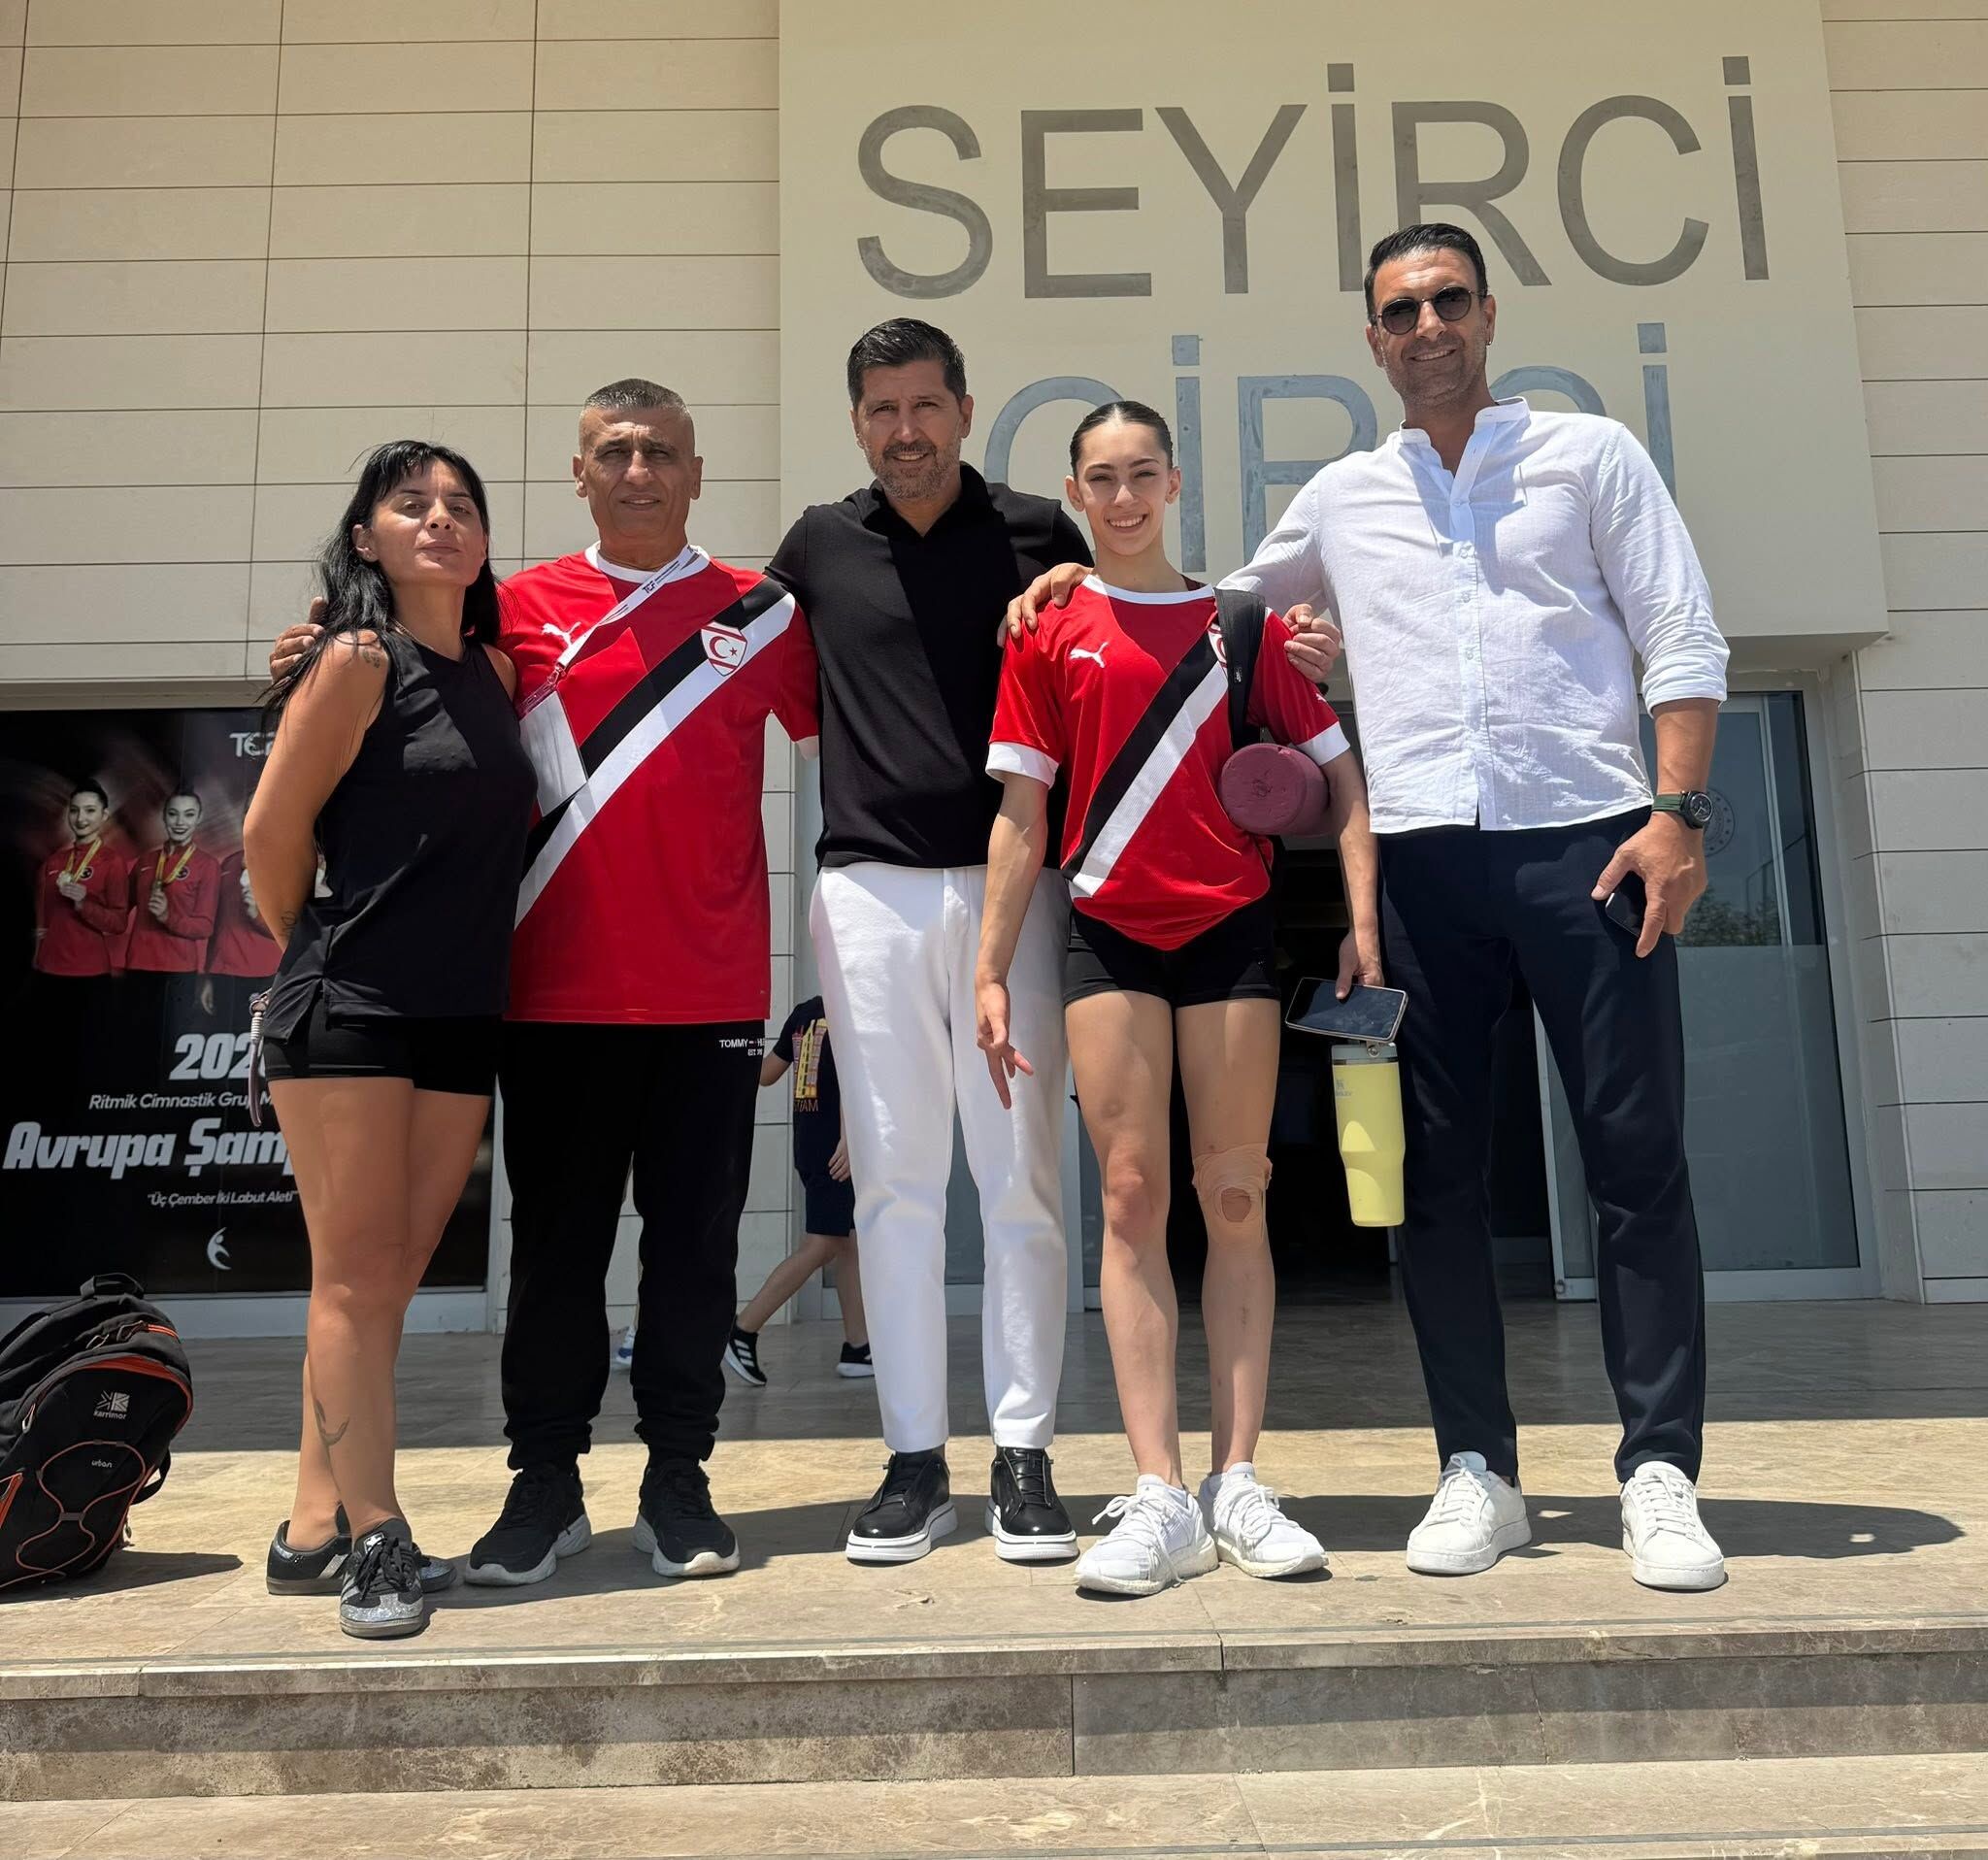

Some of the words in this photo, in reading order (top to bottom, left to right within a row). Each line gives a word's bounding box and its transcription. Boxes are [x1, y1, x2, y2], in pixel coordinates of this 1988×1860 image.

[857, 56, 1771, 299] SEYİRCİ
[169, 1032, 266, 1080] 202
[719, 1039, 748, 1048] TOMMY
[89, 1094, 137, 1110] Ritmik
[140, 1092, 215, 1109] Cimnastik
[2, 1121, 177, 1179] Avrupa
[168, 1192, 216, 1208] Çember
[230, 1191, 266, 1204] Labut
